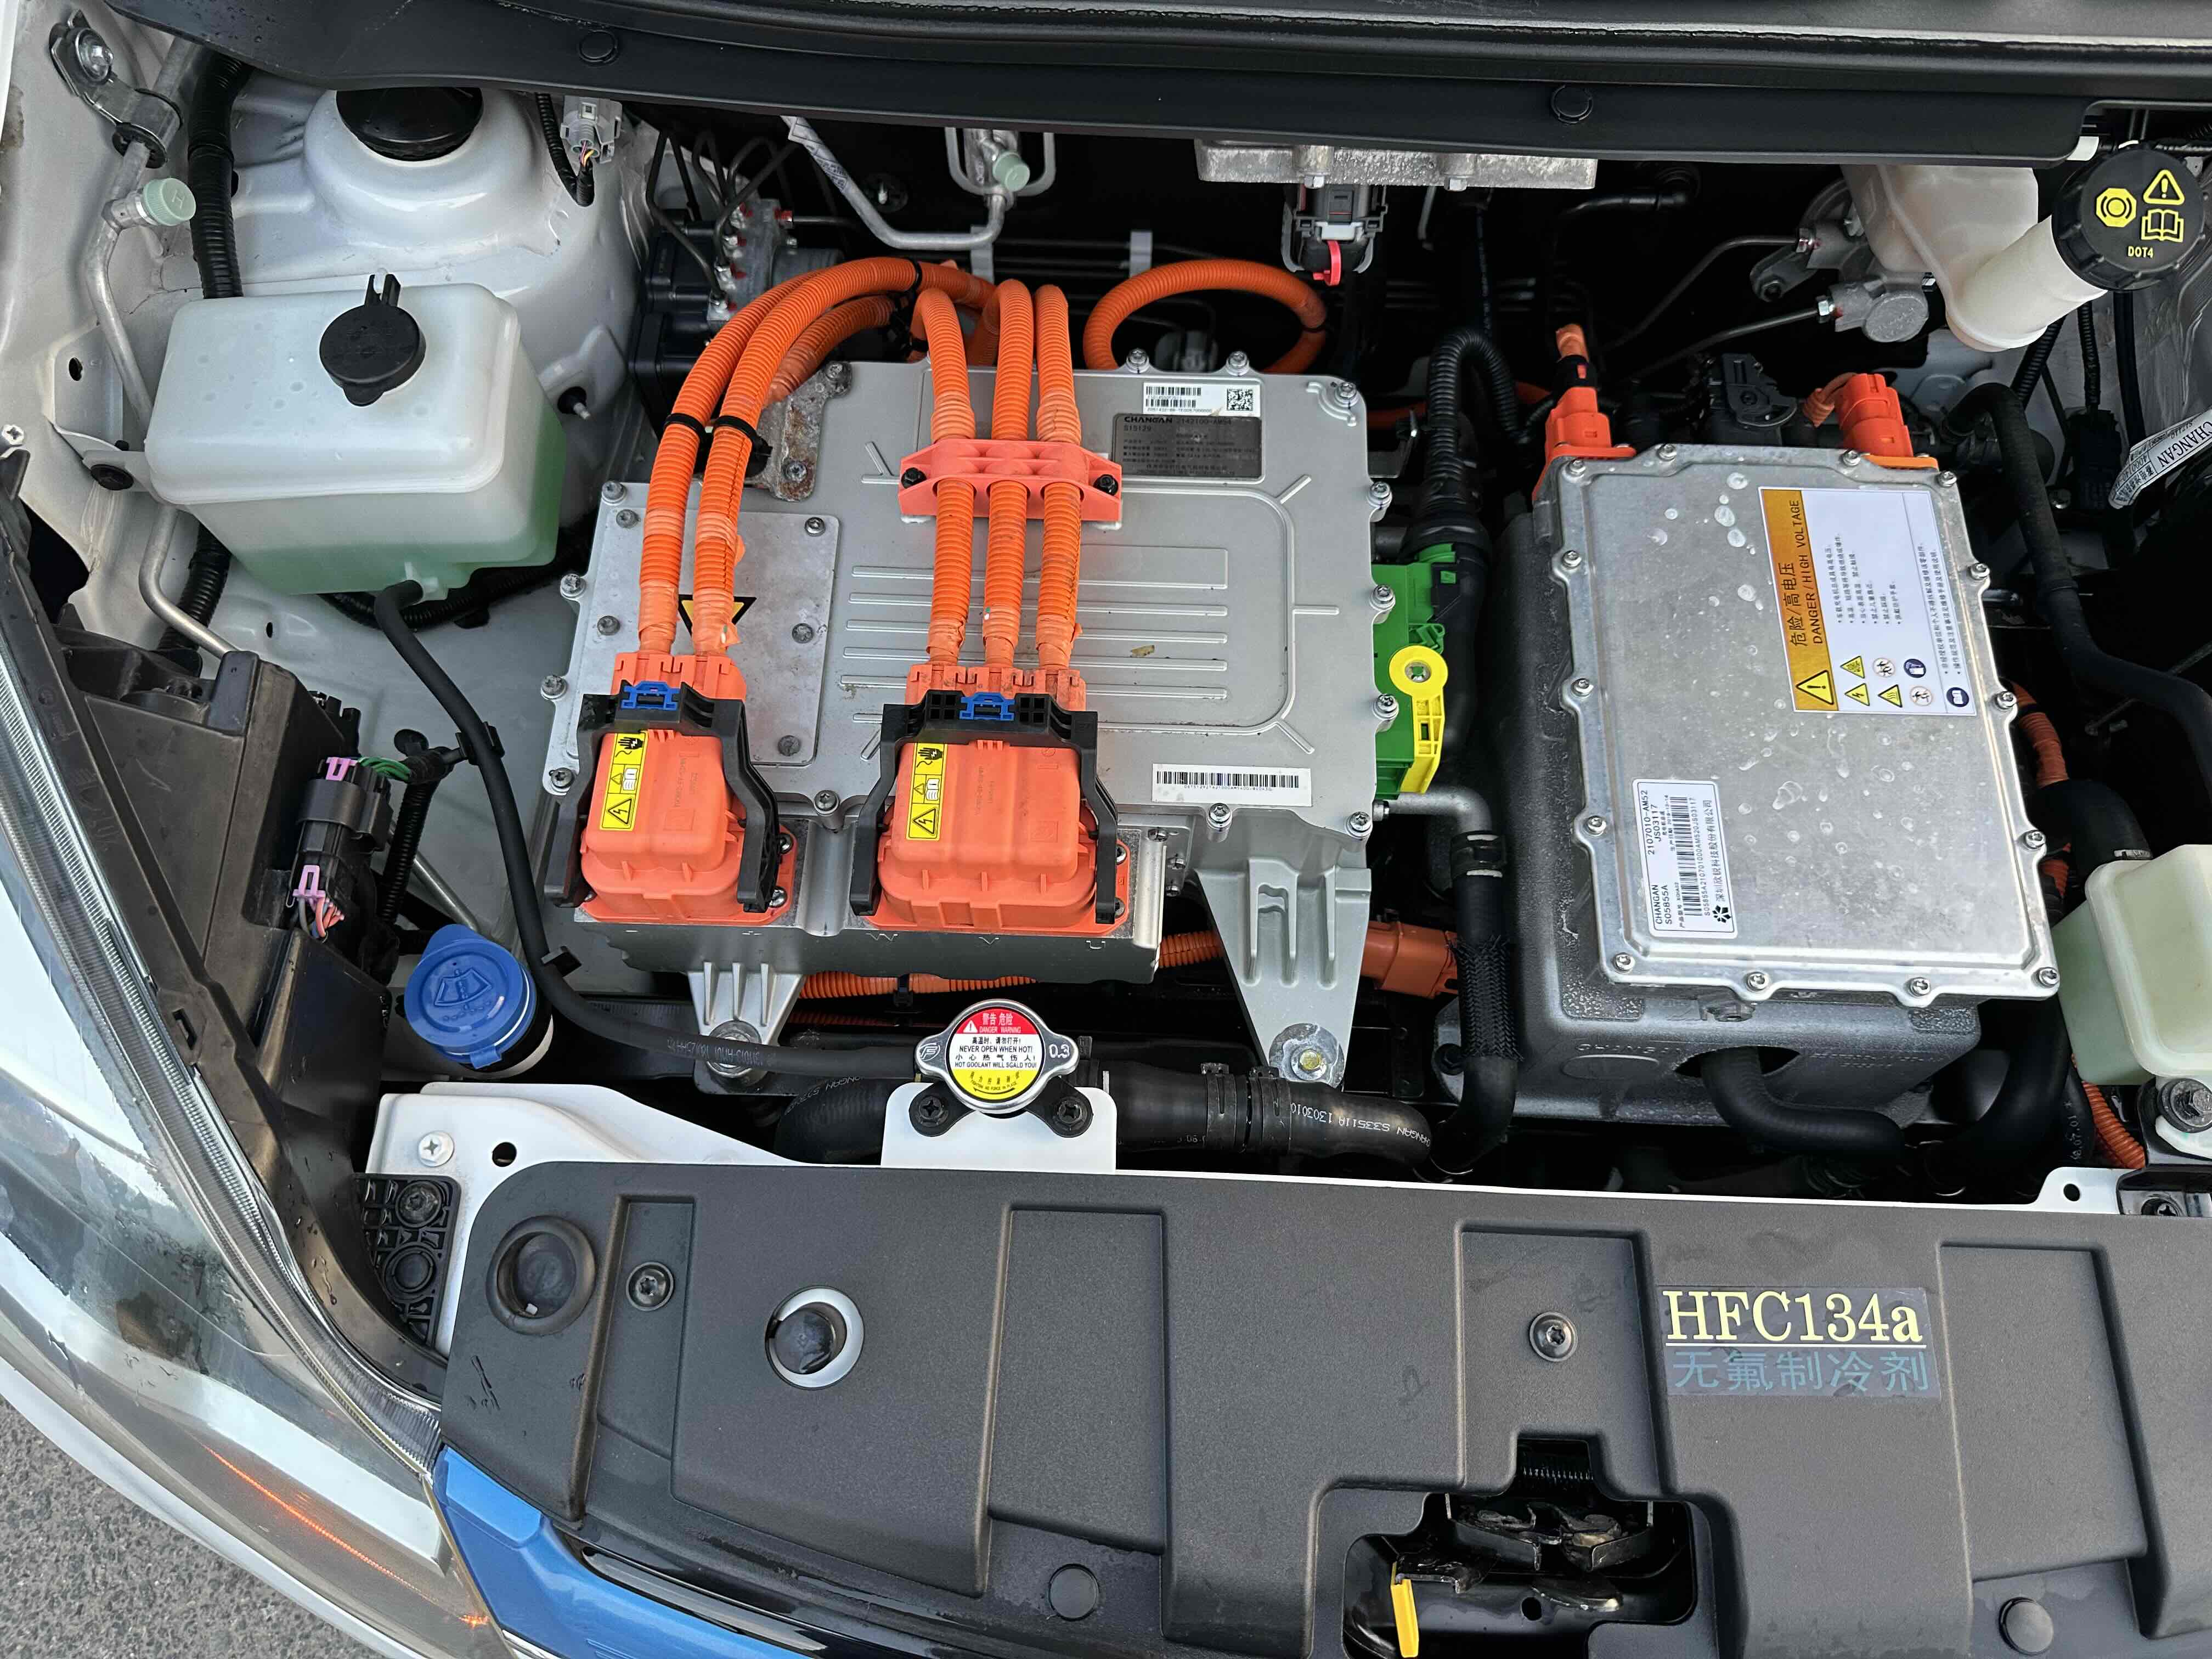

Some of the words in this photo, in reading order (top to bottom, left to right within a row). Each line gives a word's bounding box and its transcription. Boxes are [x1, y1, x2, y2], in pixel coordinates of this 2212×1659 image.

[2128, 246, 2154, 258] DOT4
[2157, 421, 2212, 467] CHANGAN
[1789, 500, 1805, 548] VOLTAGE
[1778, 562, 1808, 647] 危险/高电压
[1641, 790, 1655, 855] 2107010-AM52
[1650, 804, 1661, 842] JS03117
[1651, 884, 1663, 924] CHANGAN
[1048, 1043, 1070, 1059] 0.3
[1662, 1290, 1923, 1342] HFC134a
[1672, 1351, 1929, 1392] 无氟制冷剂
